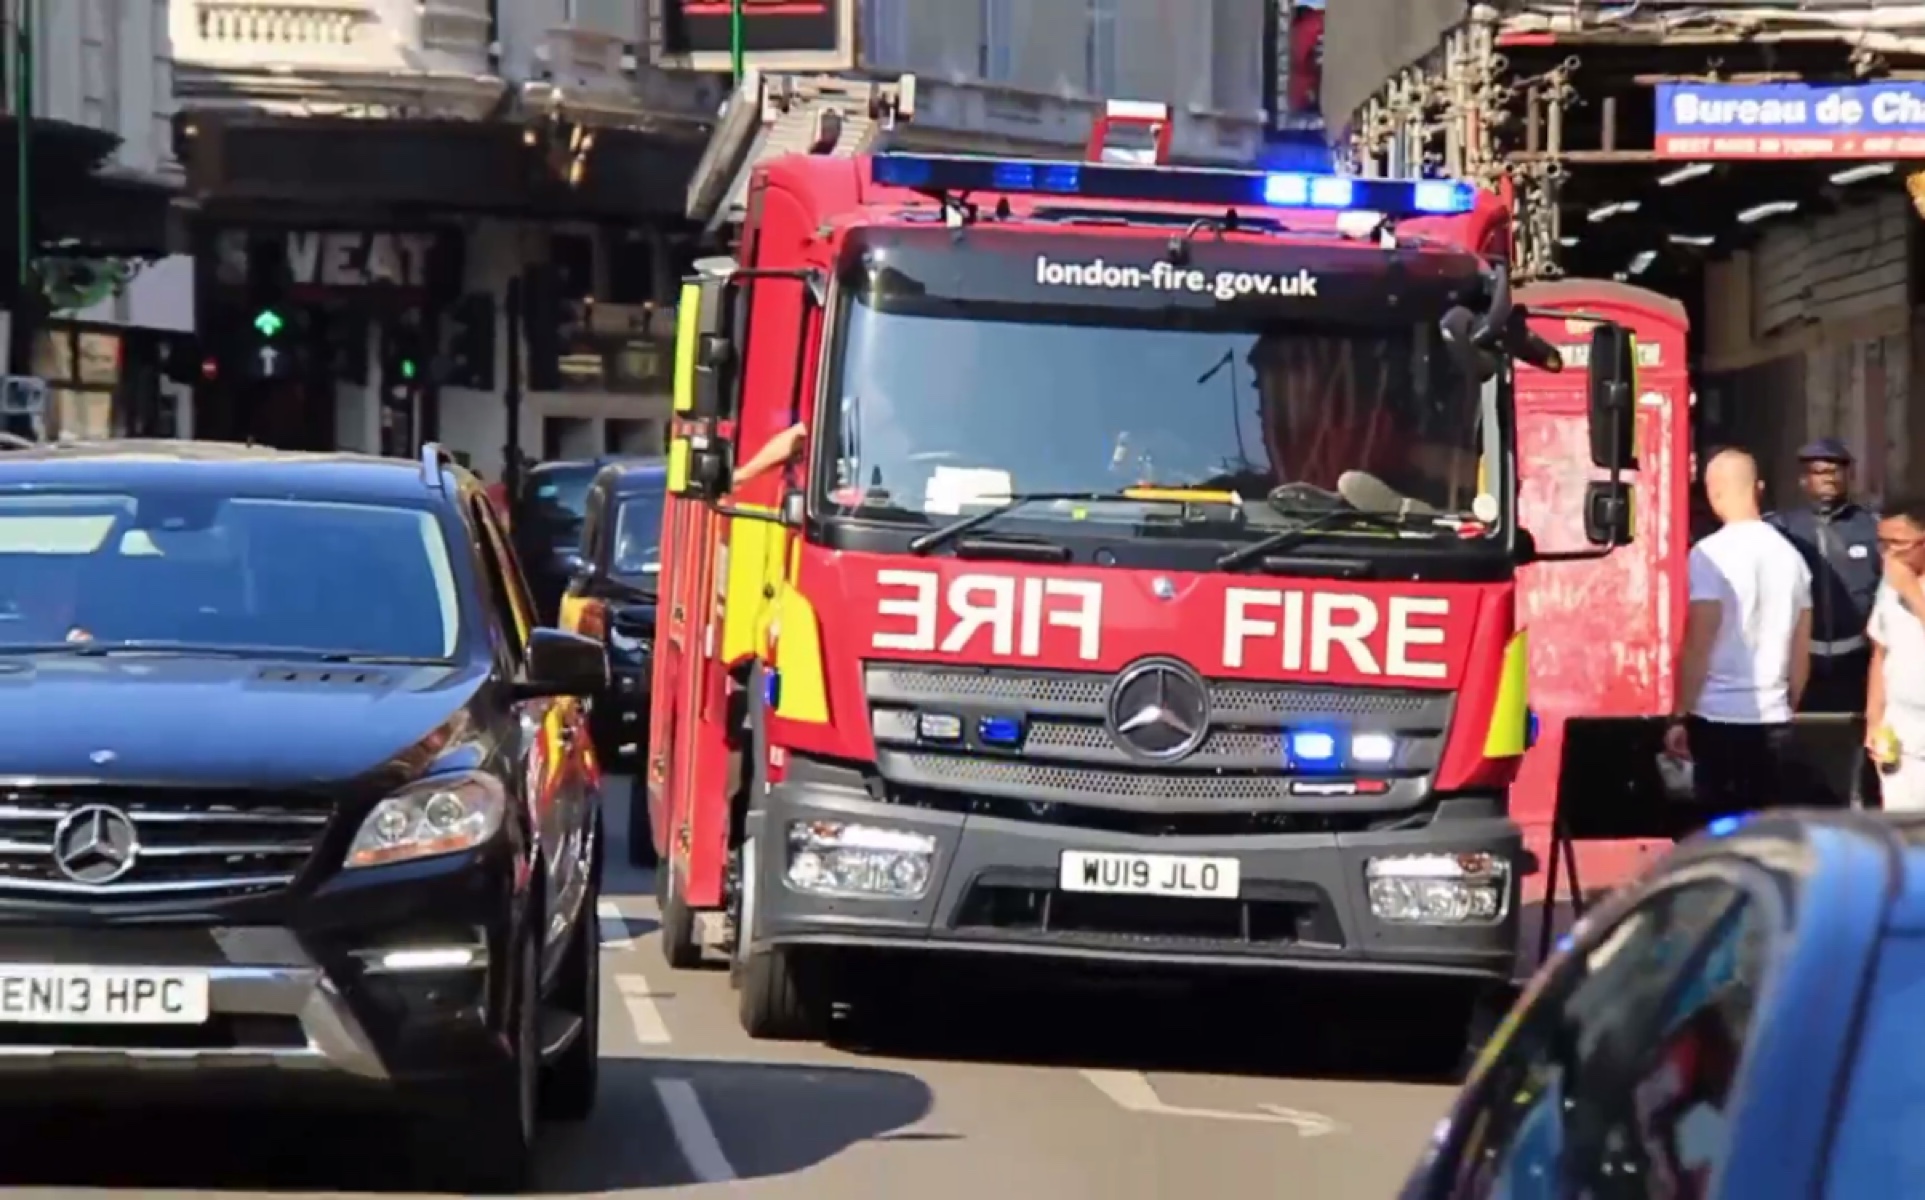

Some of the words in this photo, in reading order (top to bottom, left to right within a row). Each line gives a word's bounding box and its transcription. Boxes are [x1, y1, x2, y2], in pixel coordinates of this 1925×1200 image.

[1674, 93, 1806, 124] Bureau
[1815, 93, 1863, 124] de
[1036, 255, 1318, 300] london-fire.gov.uk
[1223, 587, 1450, 678] FIRE
[1082, 857, 1150, 888] WU19
[1161, 862, 1219, 891] JLO
[2, 977, 91, 1013] EN13
[105, 977, 183, 1013] HPC
